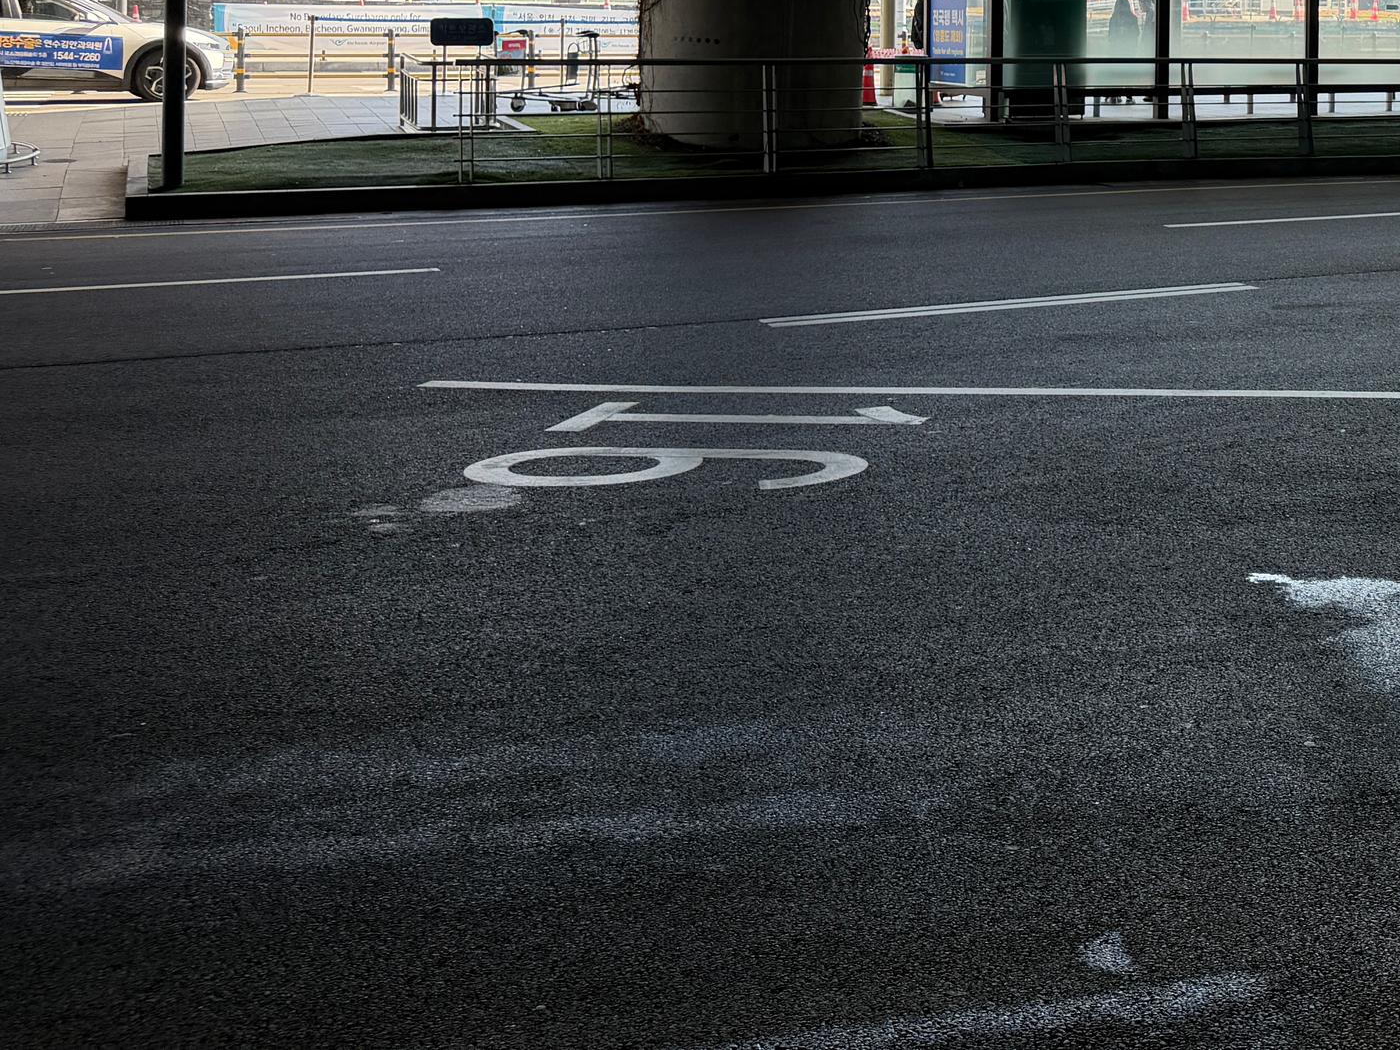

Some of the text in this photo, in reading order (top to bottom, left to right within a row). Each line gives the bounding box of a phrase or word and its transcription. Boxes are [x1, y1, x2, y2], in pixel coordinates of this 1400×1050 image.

[289, 12, 303, 21] No
[265, 24, 304, 34] Incheon,
[53, 51, 101, 62] 1544-7260
